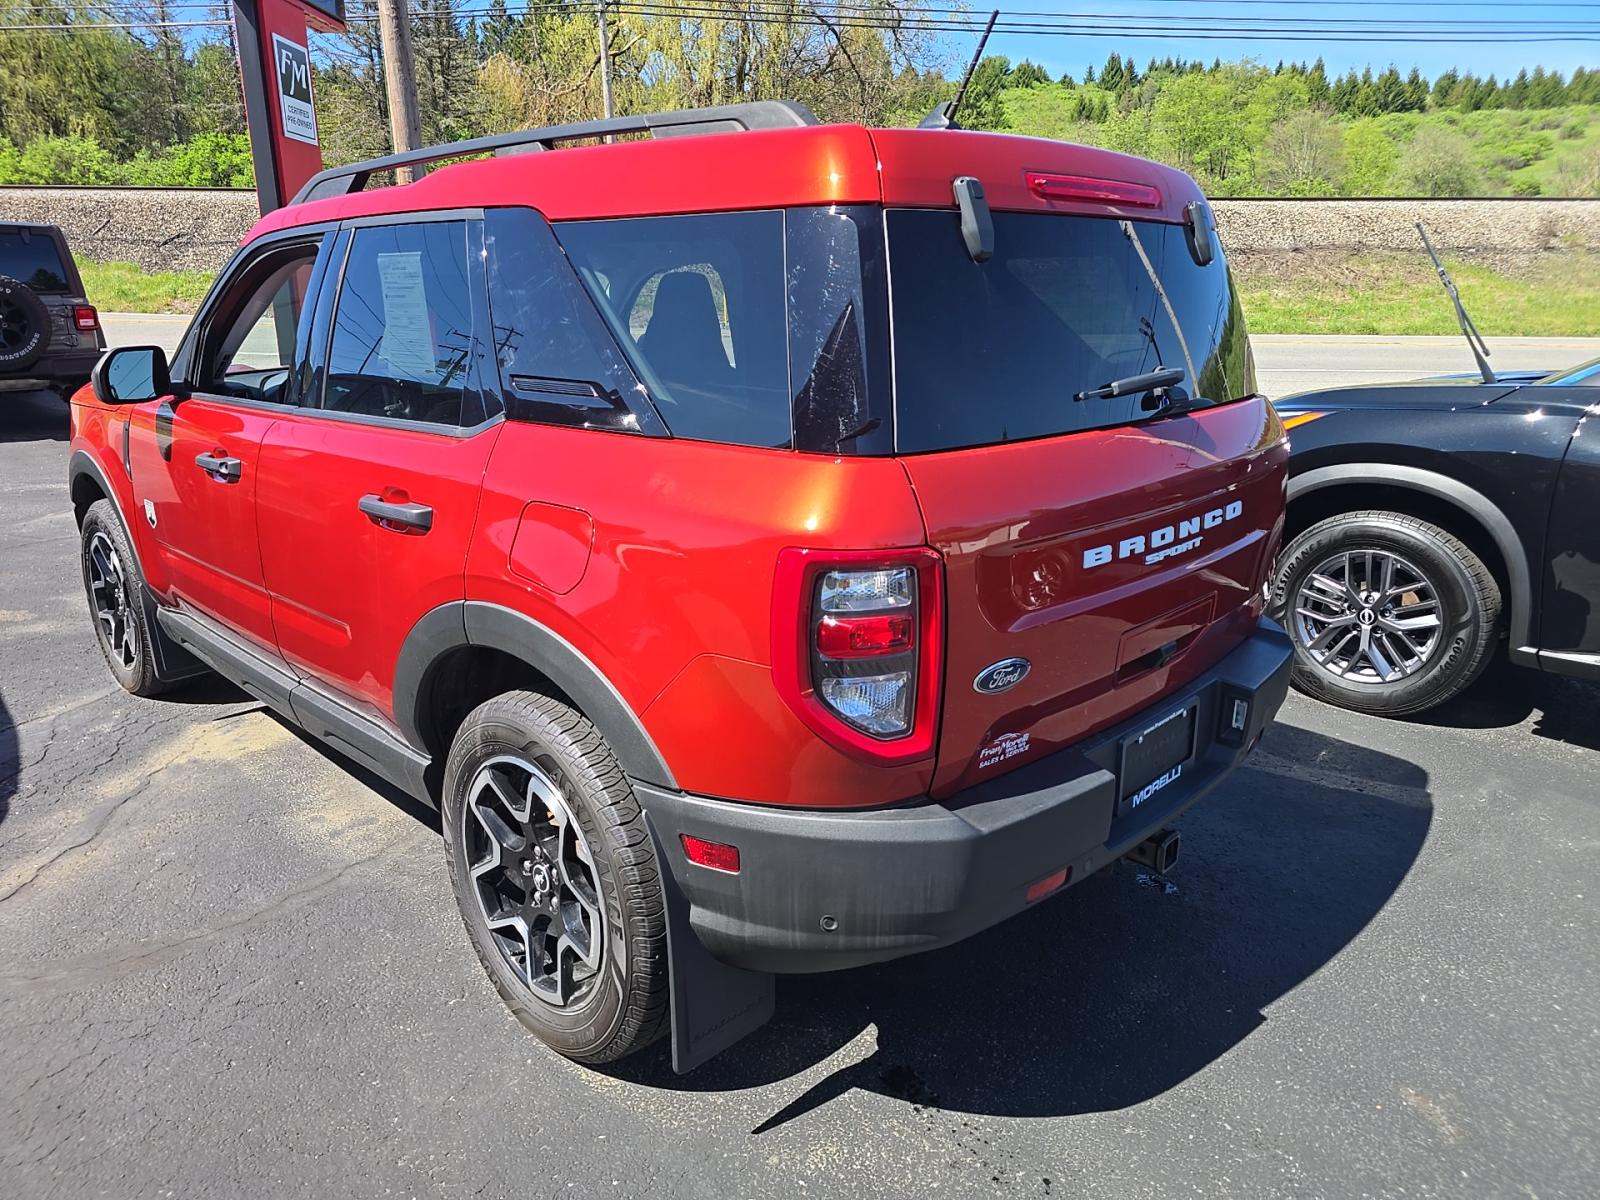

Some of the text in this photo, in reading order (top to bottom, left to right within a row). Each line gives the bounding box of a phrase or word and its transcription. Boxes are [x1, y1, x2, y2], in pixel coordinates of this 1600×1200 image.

[287, 103, 310, 119] CERTIFIED
[1082, 500, 1243, 569] BRONCO
[1144, 536, 1204, 565] SPORT
[988, 666, 1021, 689] Ford
[978, 756, 1000, 769] SALES
[1131, 764, 1182, 808] MORELLI
